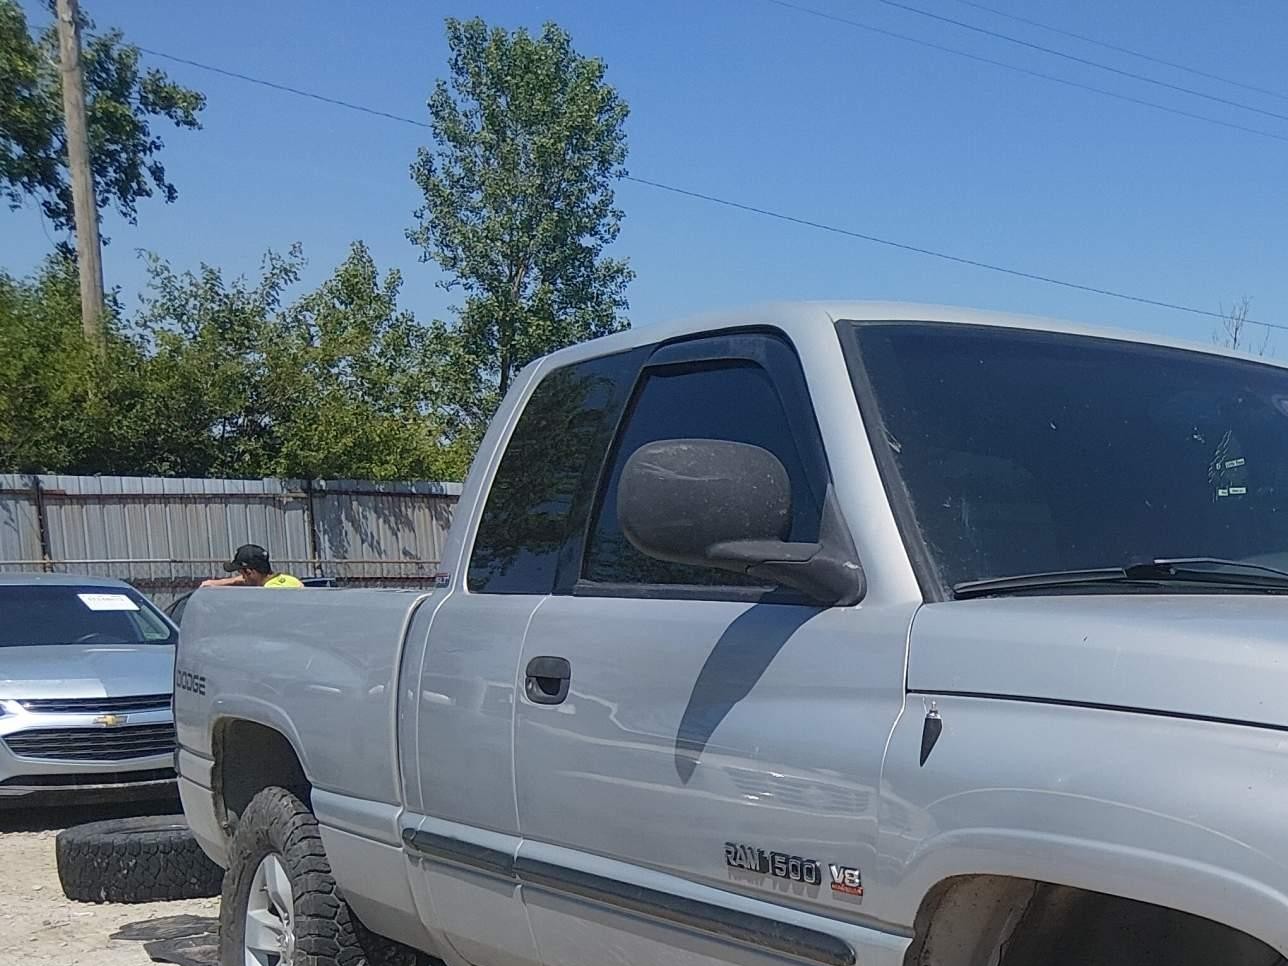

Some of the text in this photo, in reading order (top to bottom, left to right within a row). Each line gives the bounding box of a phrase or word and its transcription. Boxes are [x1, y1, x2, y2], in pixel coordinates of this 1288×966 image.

[177, 669, 206, 696] DODGE
[723, 842, 862, 888] RAM 1500 V8
